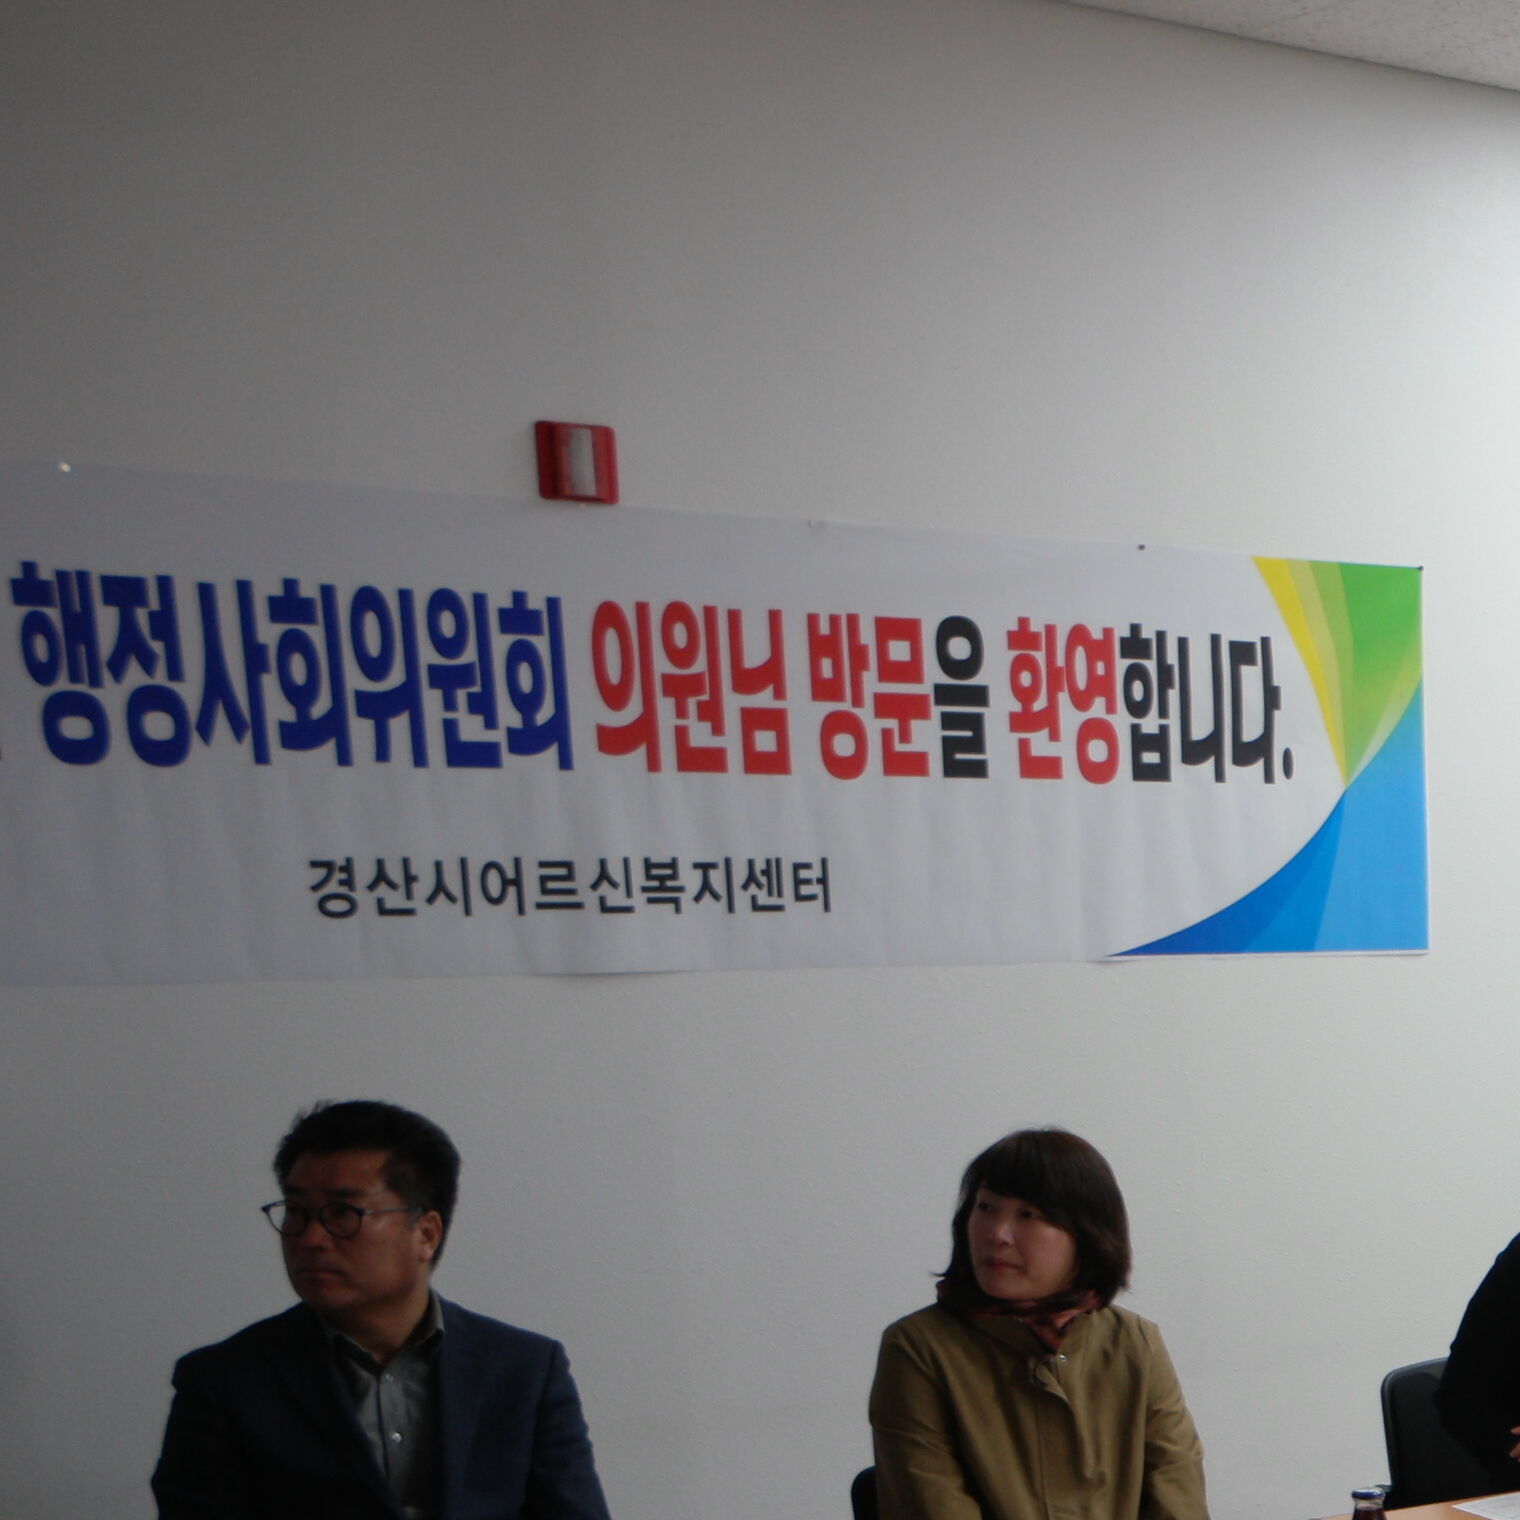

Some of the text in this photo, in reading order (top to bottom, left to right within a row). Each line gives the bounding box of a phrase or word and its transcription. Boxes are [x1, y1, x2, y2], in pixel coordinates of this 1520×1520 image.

[10, 560, 1295, 785] 행정사회위원회 의원님 방문을 환영합니다.
[308, 856, 833, 919] 경산시어르신복지센터
